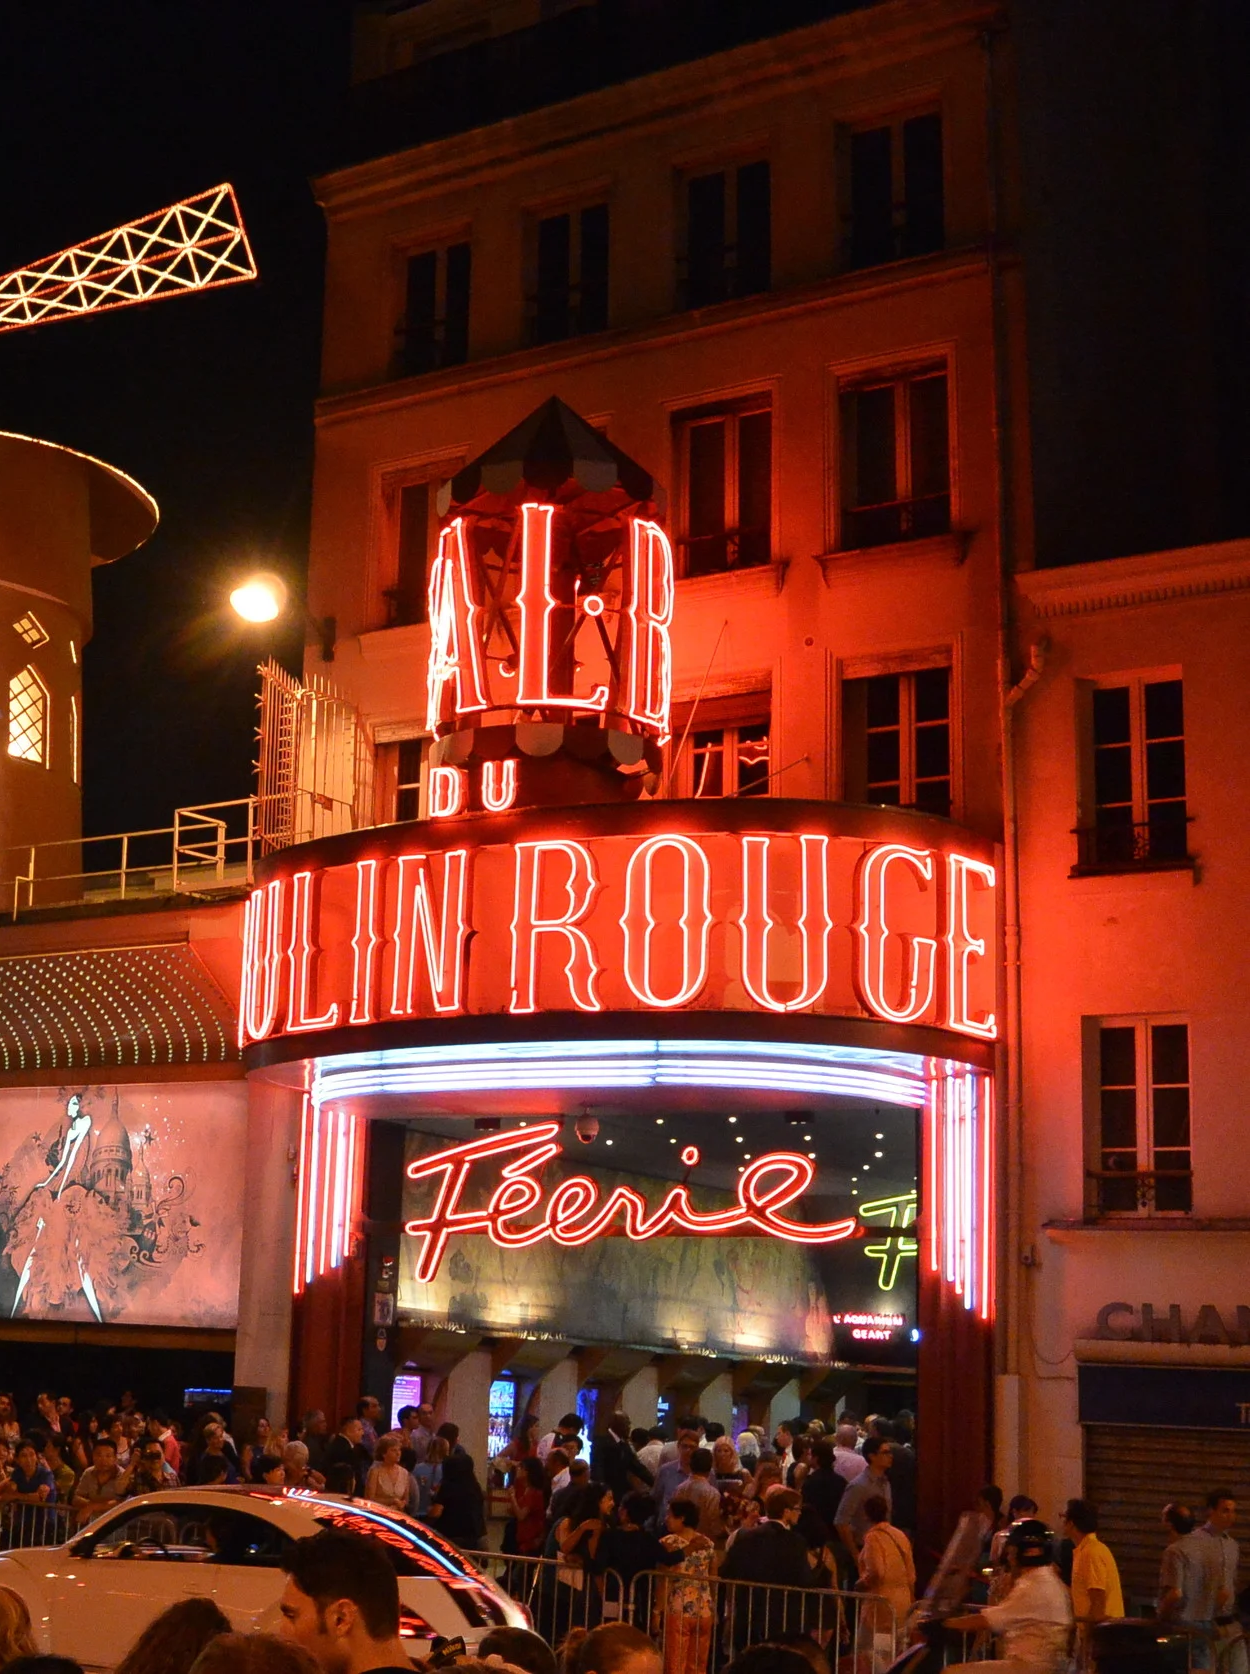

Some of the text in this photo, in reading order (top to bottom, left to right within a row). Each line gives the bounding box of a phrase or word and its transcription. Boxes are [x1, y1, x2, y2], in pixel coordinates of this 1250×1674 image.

[429, 758, 517, 818] DU
[510, 833, 998, 1040] ROUGE
[405, 1120, 858, 1284] Féerie
